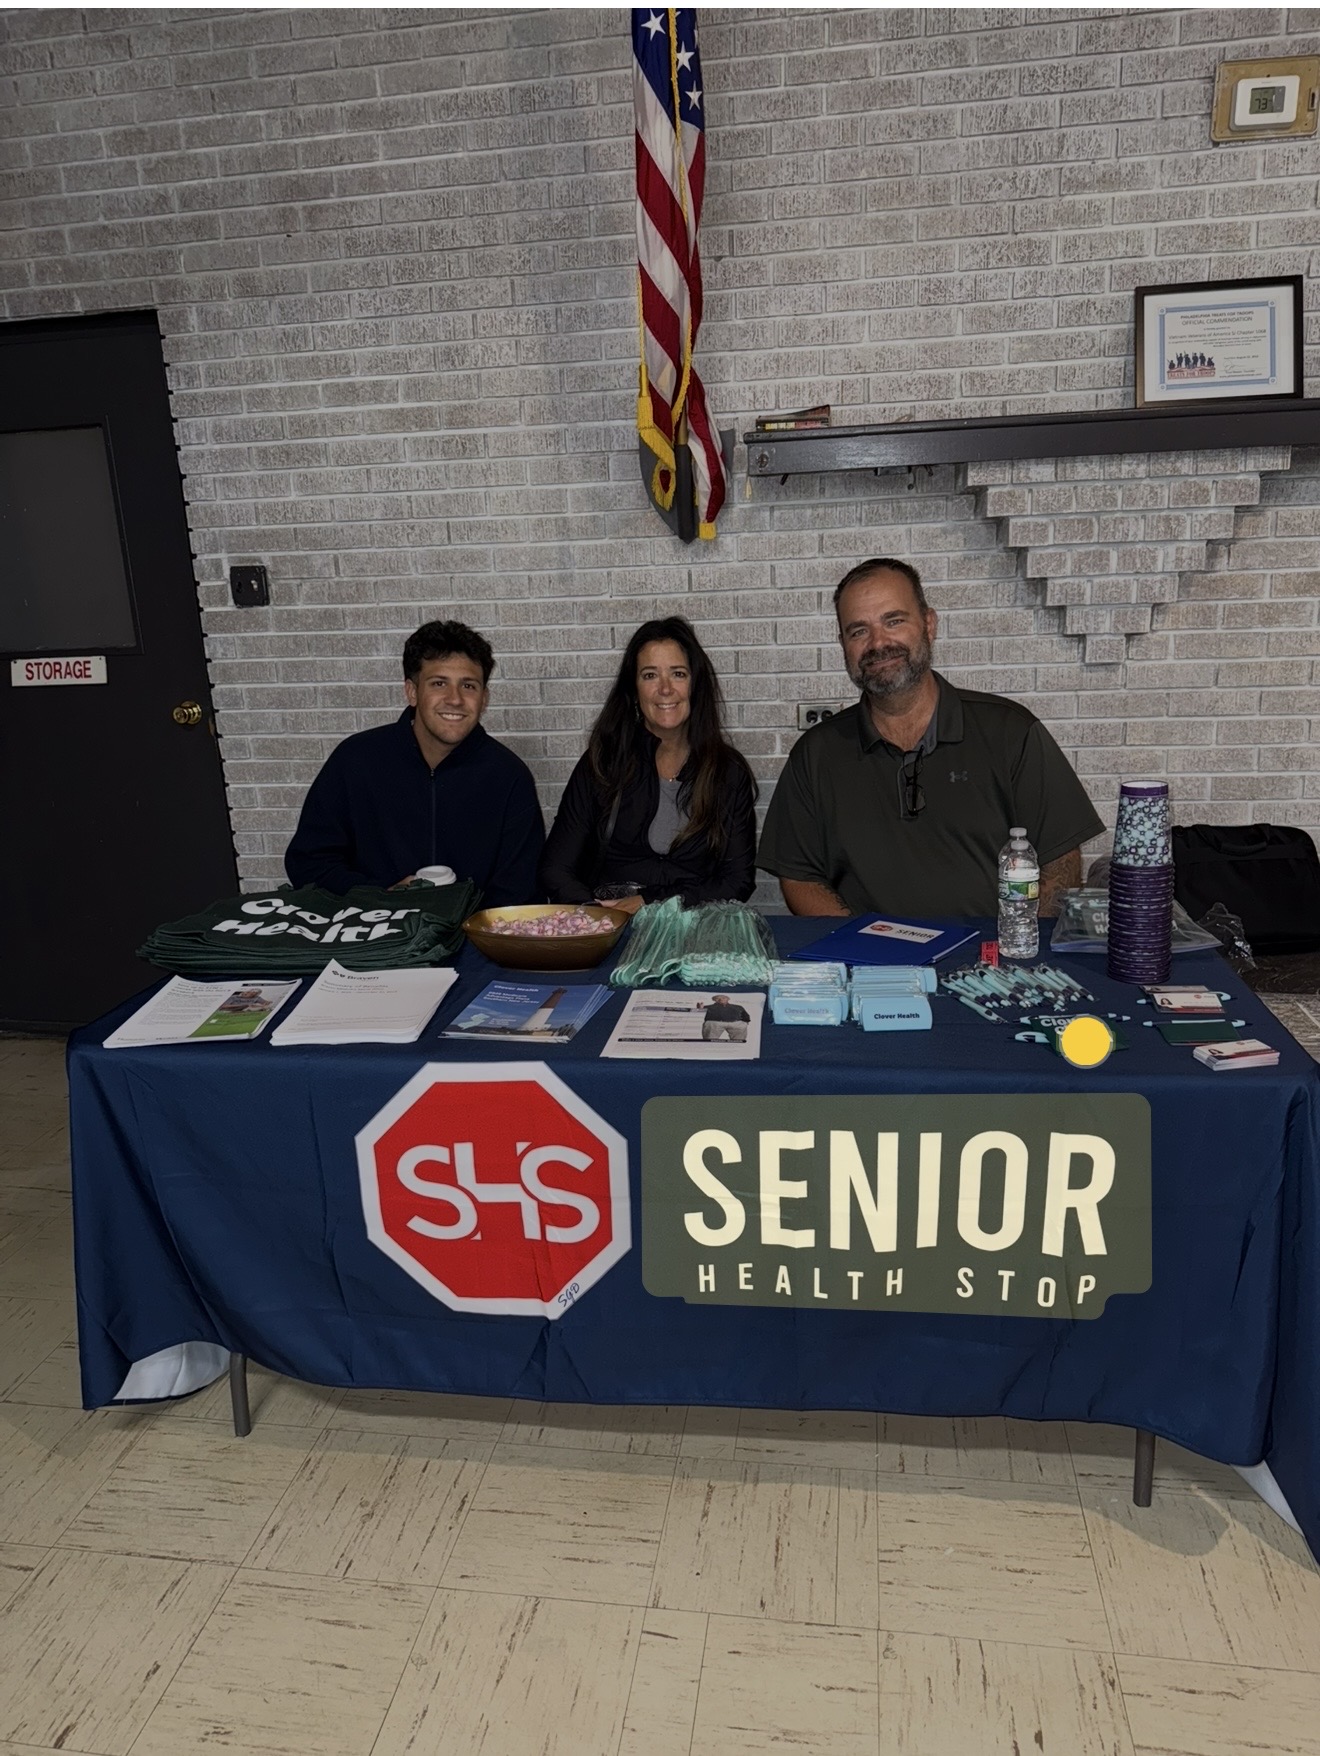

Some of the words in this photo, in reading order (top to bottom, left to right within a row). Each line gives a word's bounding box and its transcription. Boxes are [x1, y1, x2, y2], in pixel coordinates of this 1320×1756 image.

[1206, 316, 1253, 325] COMMENDATION
[25, 660, 92, 681] STORAGE
[896, 928, 934, 939] SENIOR
[397, 1142, 600, 1244] SHS
[683, 1129, 1116, 1257] SENIOR
[698, 1262, 903, 1300] HEALTH
[956, 1267, 1096, 1307] STOP
